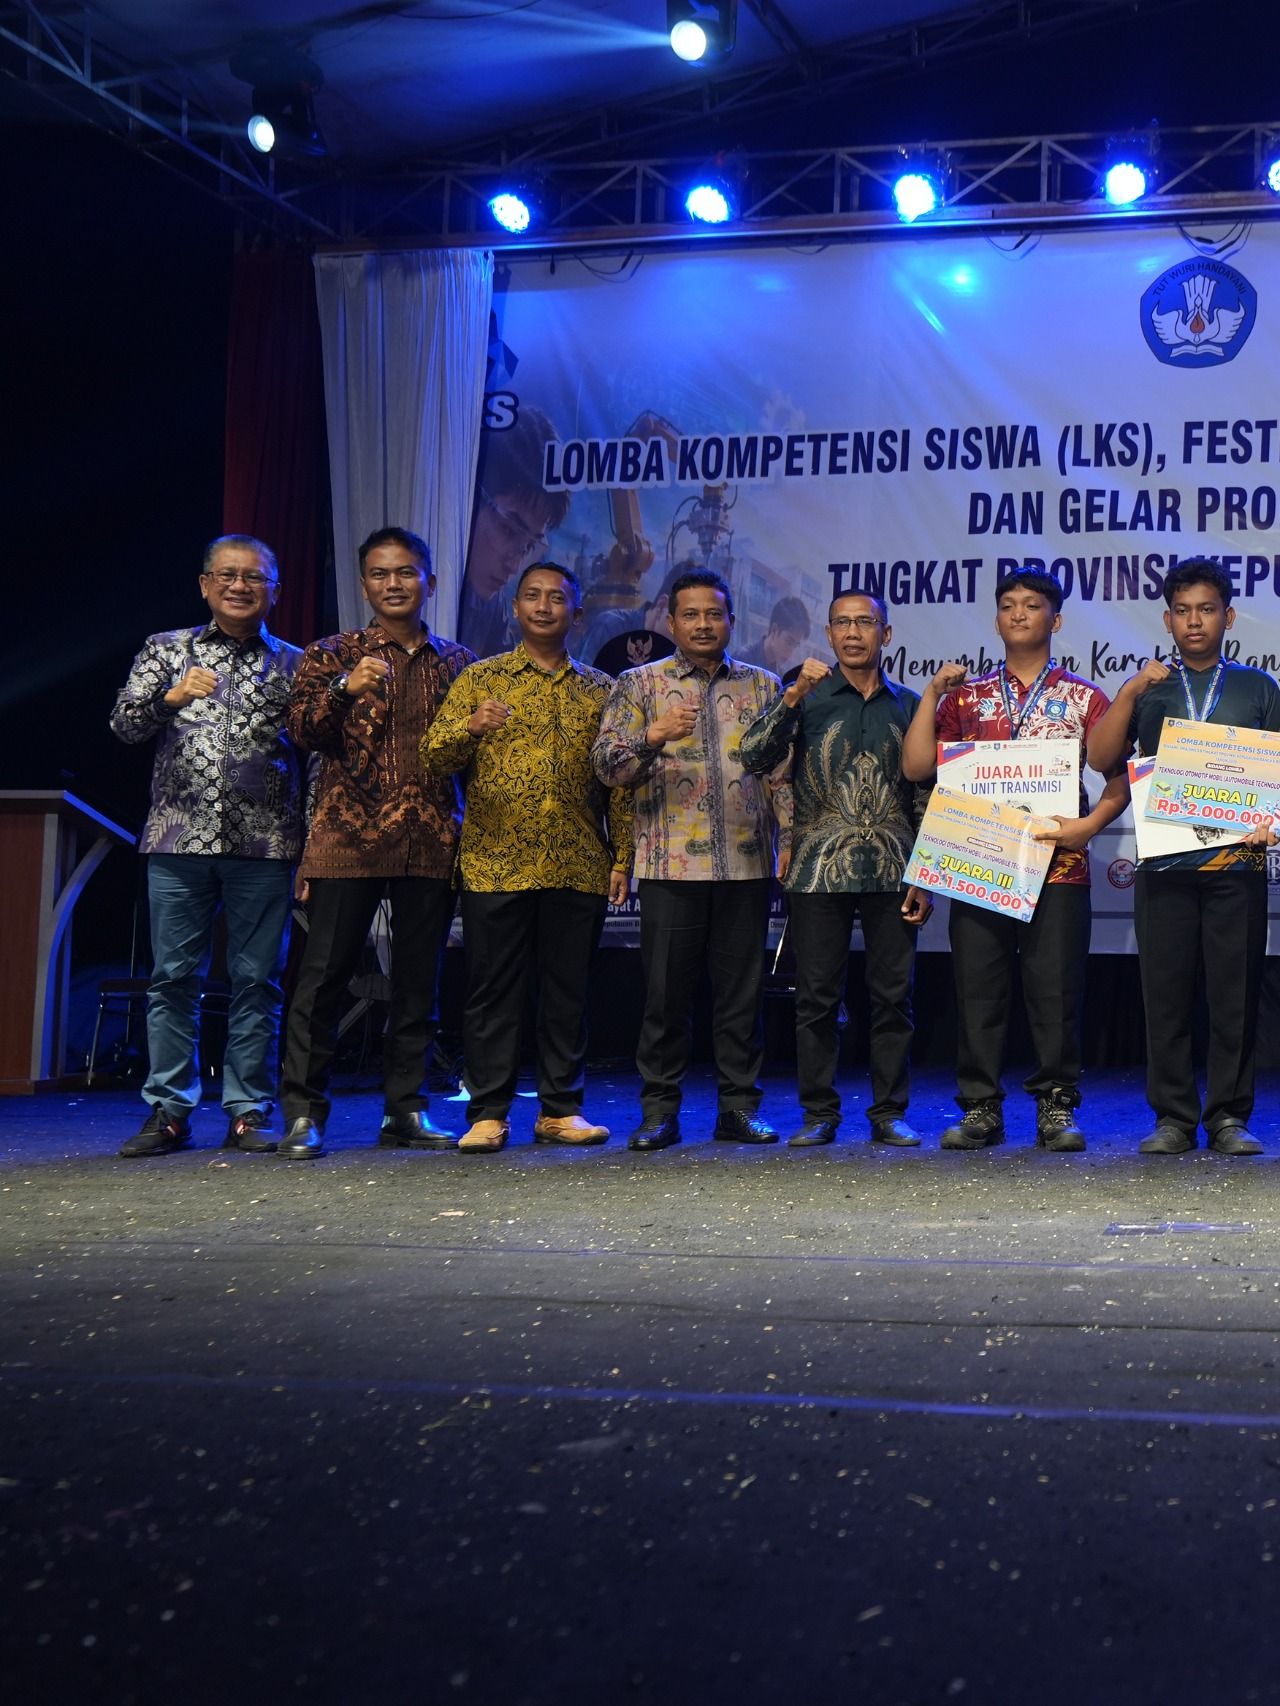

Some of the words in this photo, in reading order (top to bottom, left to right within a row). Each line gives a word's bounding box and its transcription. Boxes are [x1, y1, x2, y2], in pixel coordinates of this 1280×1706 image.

[1152, 277, 1169, 296] TUT
[1168, 263, 1195, 280] WURI
[1197, 262, 1248, 295] HANDAYANI
[545, 440, 665, 486] LOMBA
[677, 429, 911, 481] KOMPETENSI
[923, 424, 1041, 472] SISWA
[1057, 422, 1166, 477] (LKS),
[967, 490, 1044, 535] DAN
[1058, 487, 1182, 534] GELAR
[827, 558, 984, 606] TINGKAT
[1176, 737, 1204, 747] LOMBA
[1205, 741, 1256, 753] KOMPETENSI
[974, 765, 1023, 779] JUARA
[1028, 764, 1043, 778] III
[1159, 766, 1185, 777] TEKNOLOGI
[1185, 770, 1209, 779] OTOMOTIF
[961, 783, 966, 793] 1
[971, 782, 997, 795] UNIT
[1000, 780, 1062, 794] TRANSMISI
[1183, 784, 1243, 806] JUARA
[1244, 792, 1259, 808] II
[943, 806, 968, 820] LOMBA
[969, 815, 1017, 835] KOMPETENSI
[1156, 799, 1183, 816] Rp.
[1187, 804, 1275, 826] 2.000.000
[940, 854, 994, 884] JUARA
[997, 872, 1014, 890] III
[918, 867, 942, 886] Rp.
[946, 875, 1022, 910] 1.500.000
